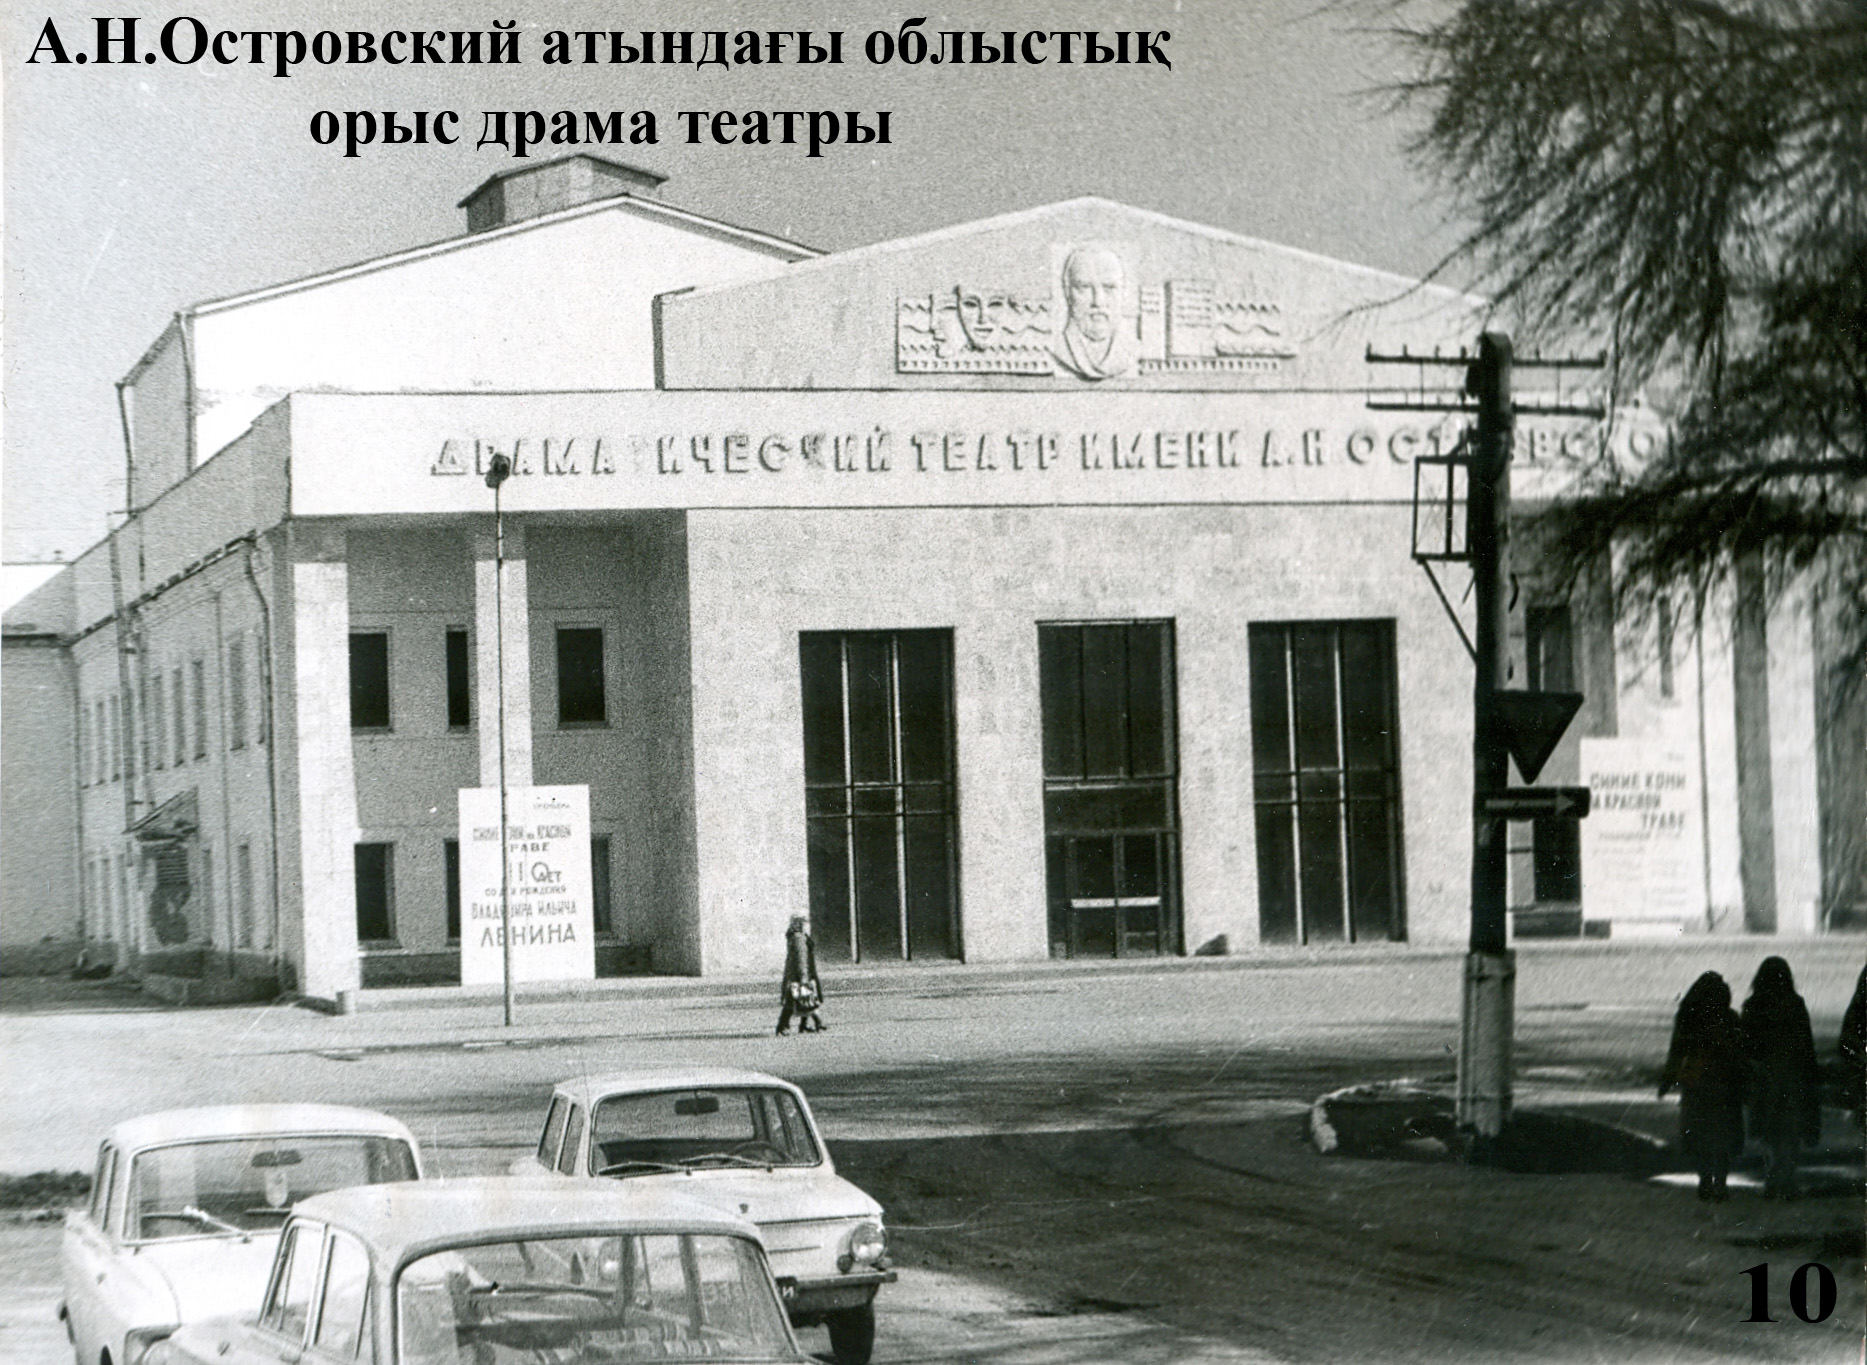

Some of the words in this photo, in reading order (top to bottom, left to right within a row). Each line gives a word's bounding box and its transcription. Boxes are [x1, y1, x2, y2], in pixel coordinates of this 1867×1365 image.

[430, 425, 892, 476] ДРАМАИЧЕСКИЙ
[910, 430, 1059, 472] ТЕАТР
[1080, 429, 1240, 470] ИМЕНИ
[1590, 771, 1640, 790] СИНИЕ
[1645, 771, 1686, 790] КОНИ
[509, 841, 551, 854] РАВЕ
[480, 922, 577, 948] ЛЕНИНА
